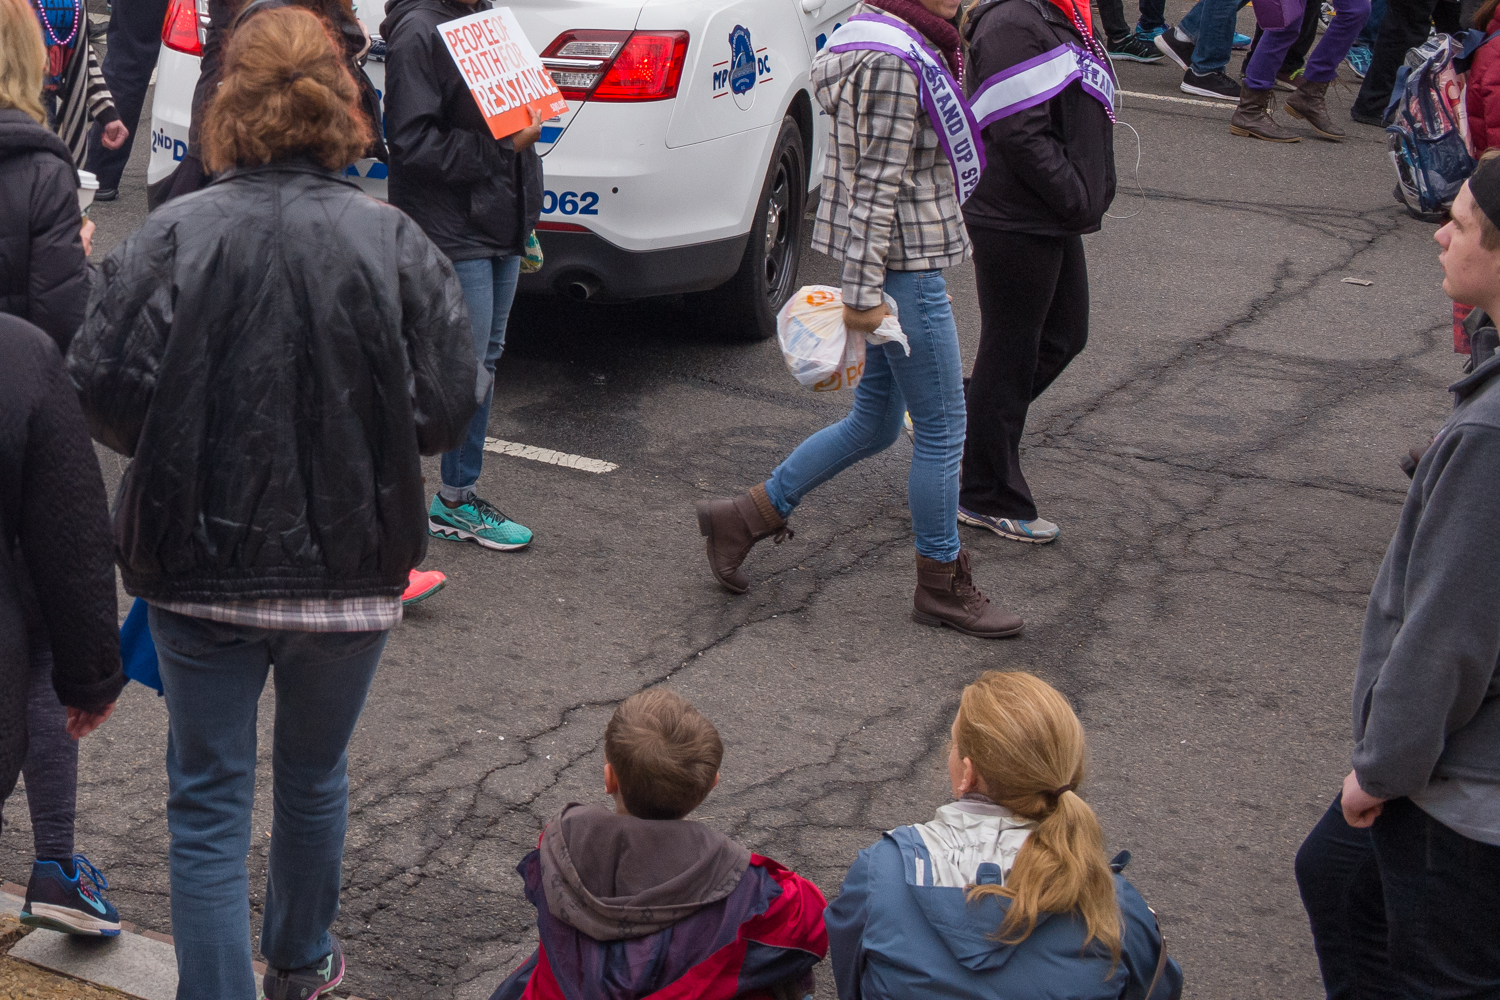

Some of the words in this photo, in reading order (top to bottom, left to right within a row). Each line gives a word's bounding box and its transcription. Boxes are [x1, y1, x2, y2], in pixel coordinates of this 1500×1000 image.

[445, 19, 500, 57] PEOPLE
[490, 15, 511, 43] OF
[458, 47, 506, 85] FAITH
[497, 42, 529, 72] FOR
[713, 69, 729, 91] MP
[757, 54, 771, 76] DC
[474, 65, 559, 118] RESISTANCE
[925, 68, 965, 137] STAND
[953, 137, 974, 164] UP
[152, 130, 173, 154] 2ND
[541, 191, 599, 216] 062
